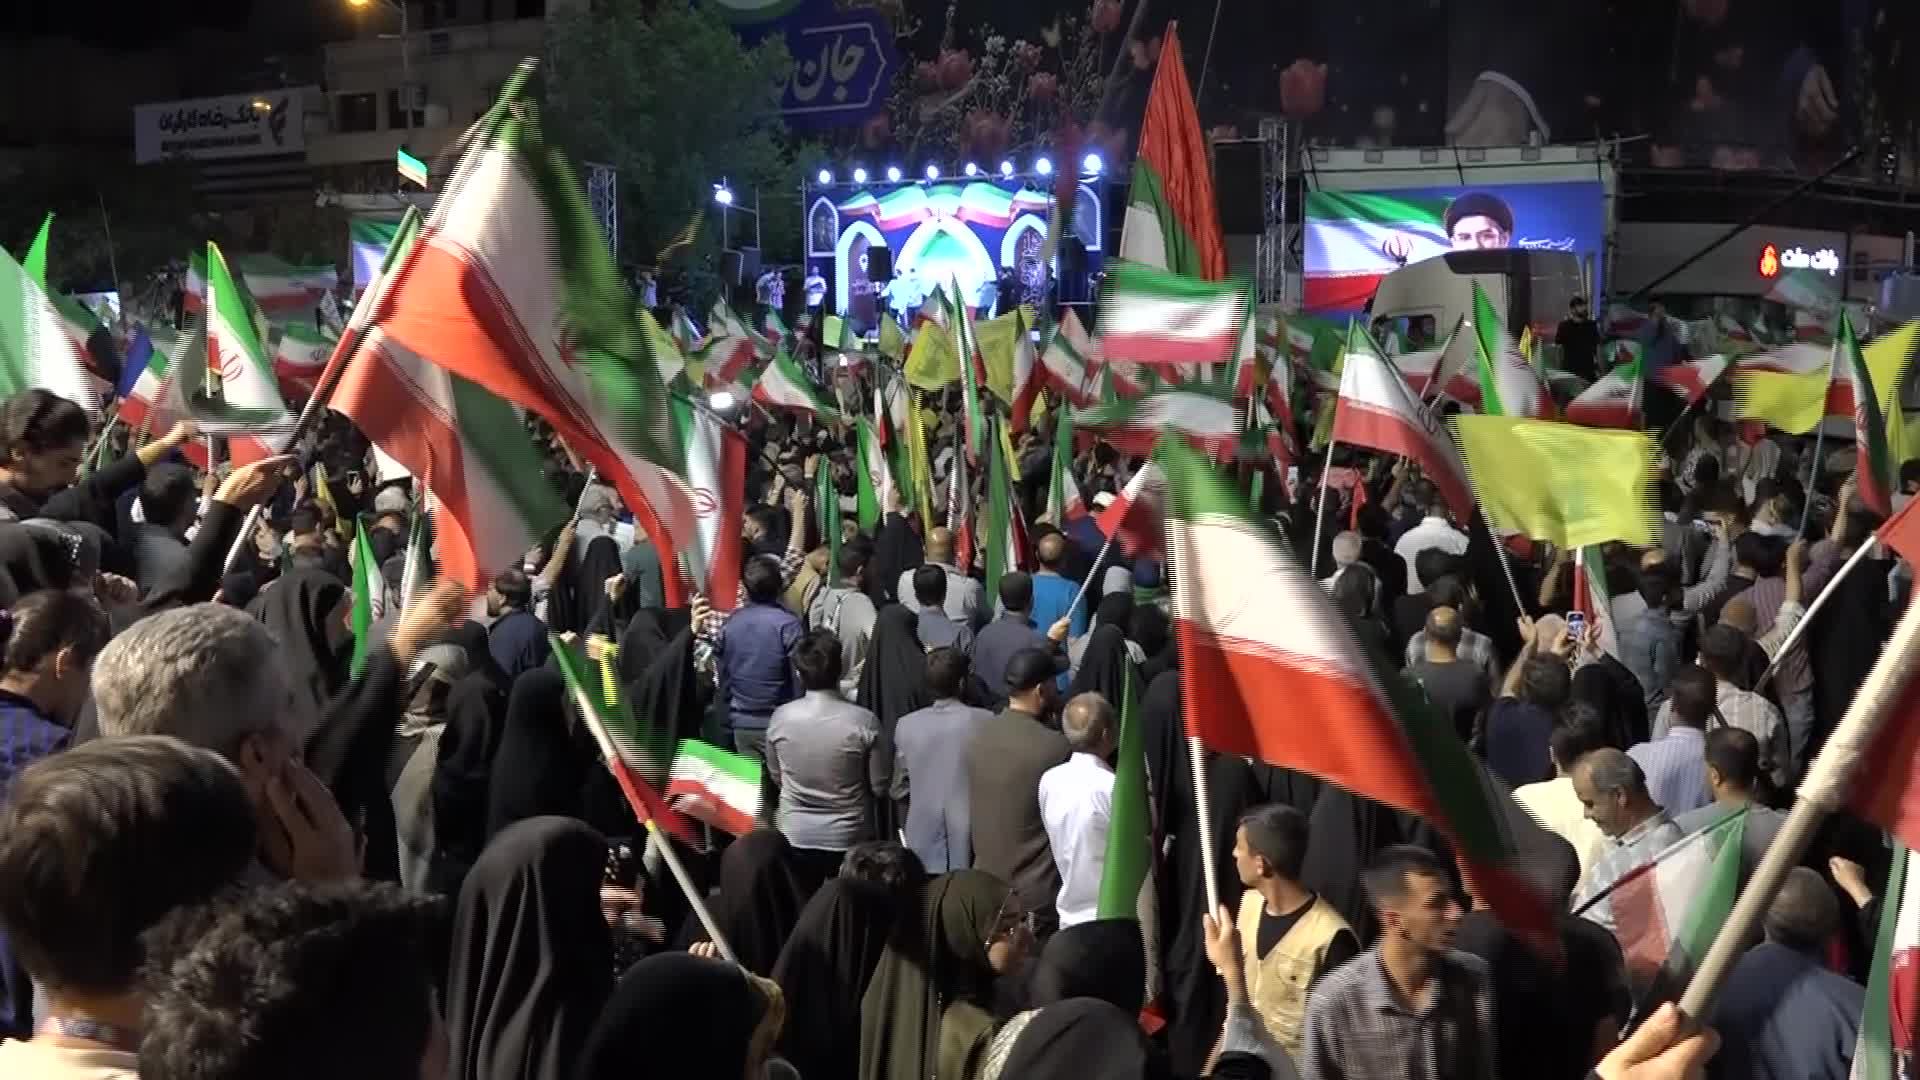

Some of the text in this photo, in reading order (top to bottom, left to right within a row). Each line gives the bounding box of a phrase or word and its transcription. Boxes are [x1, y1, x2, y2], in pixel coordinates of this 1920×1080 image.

[159, 108, 199, 135] کارگران
[199, 105, 229, 129] رفاه
[1780, 246, 1839, 277] بانک ملت
